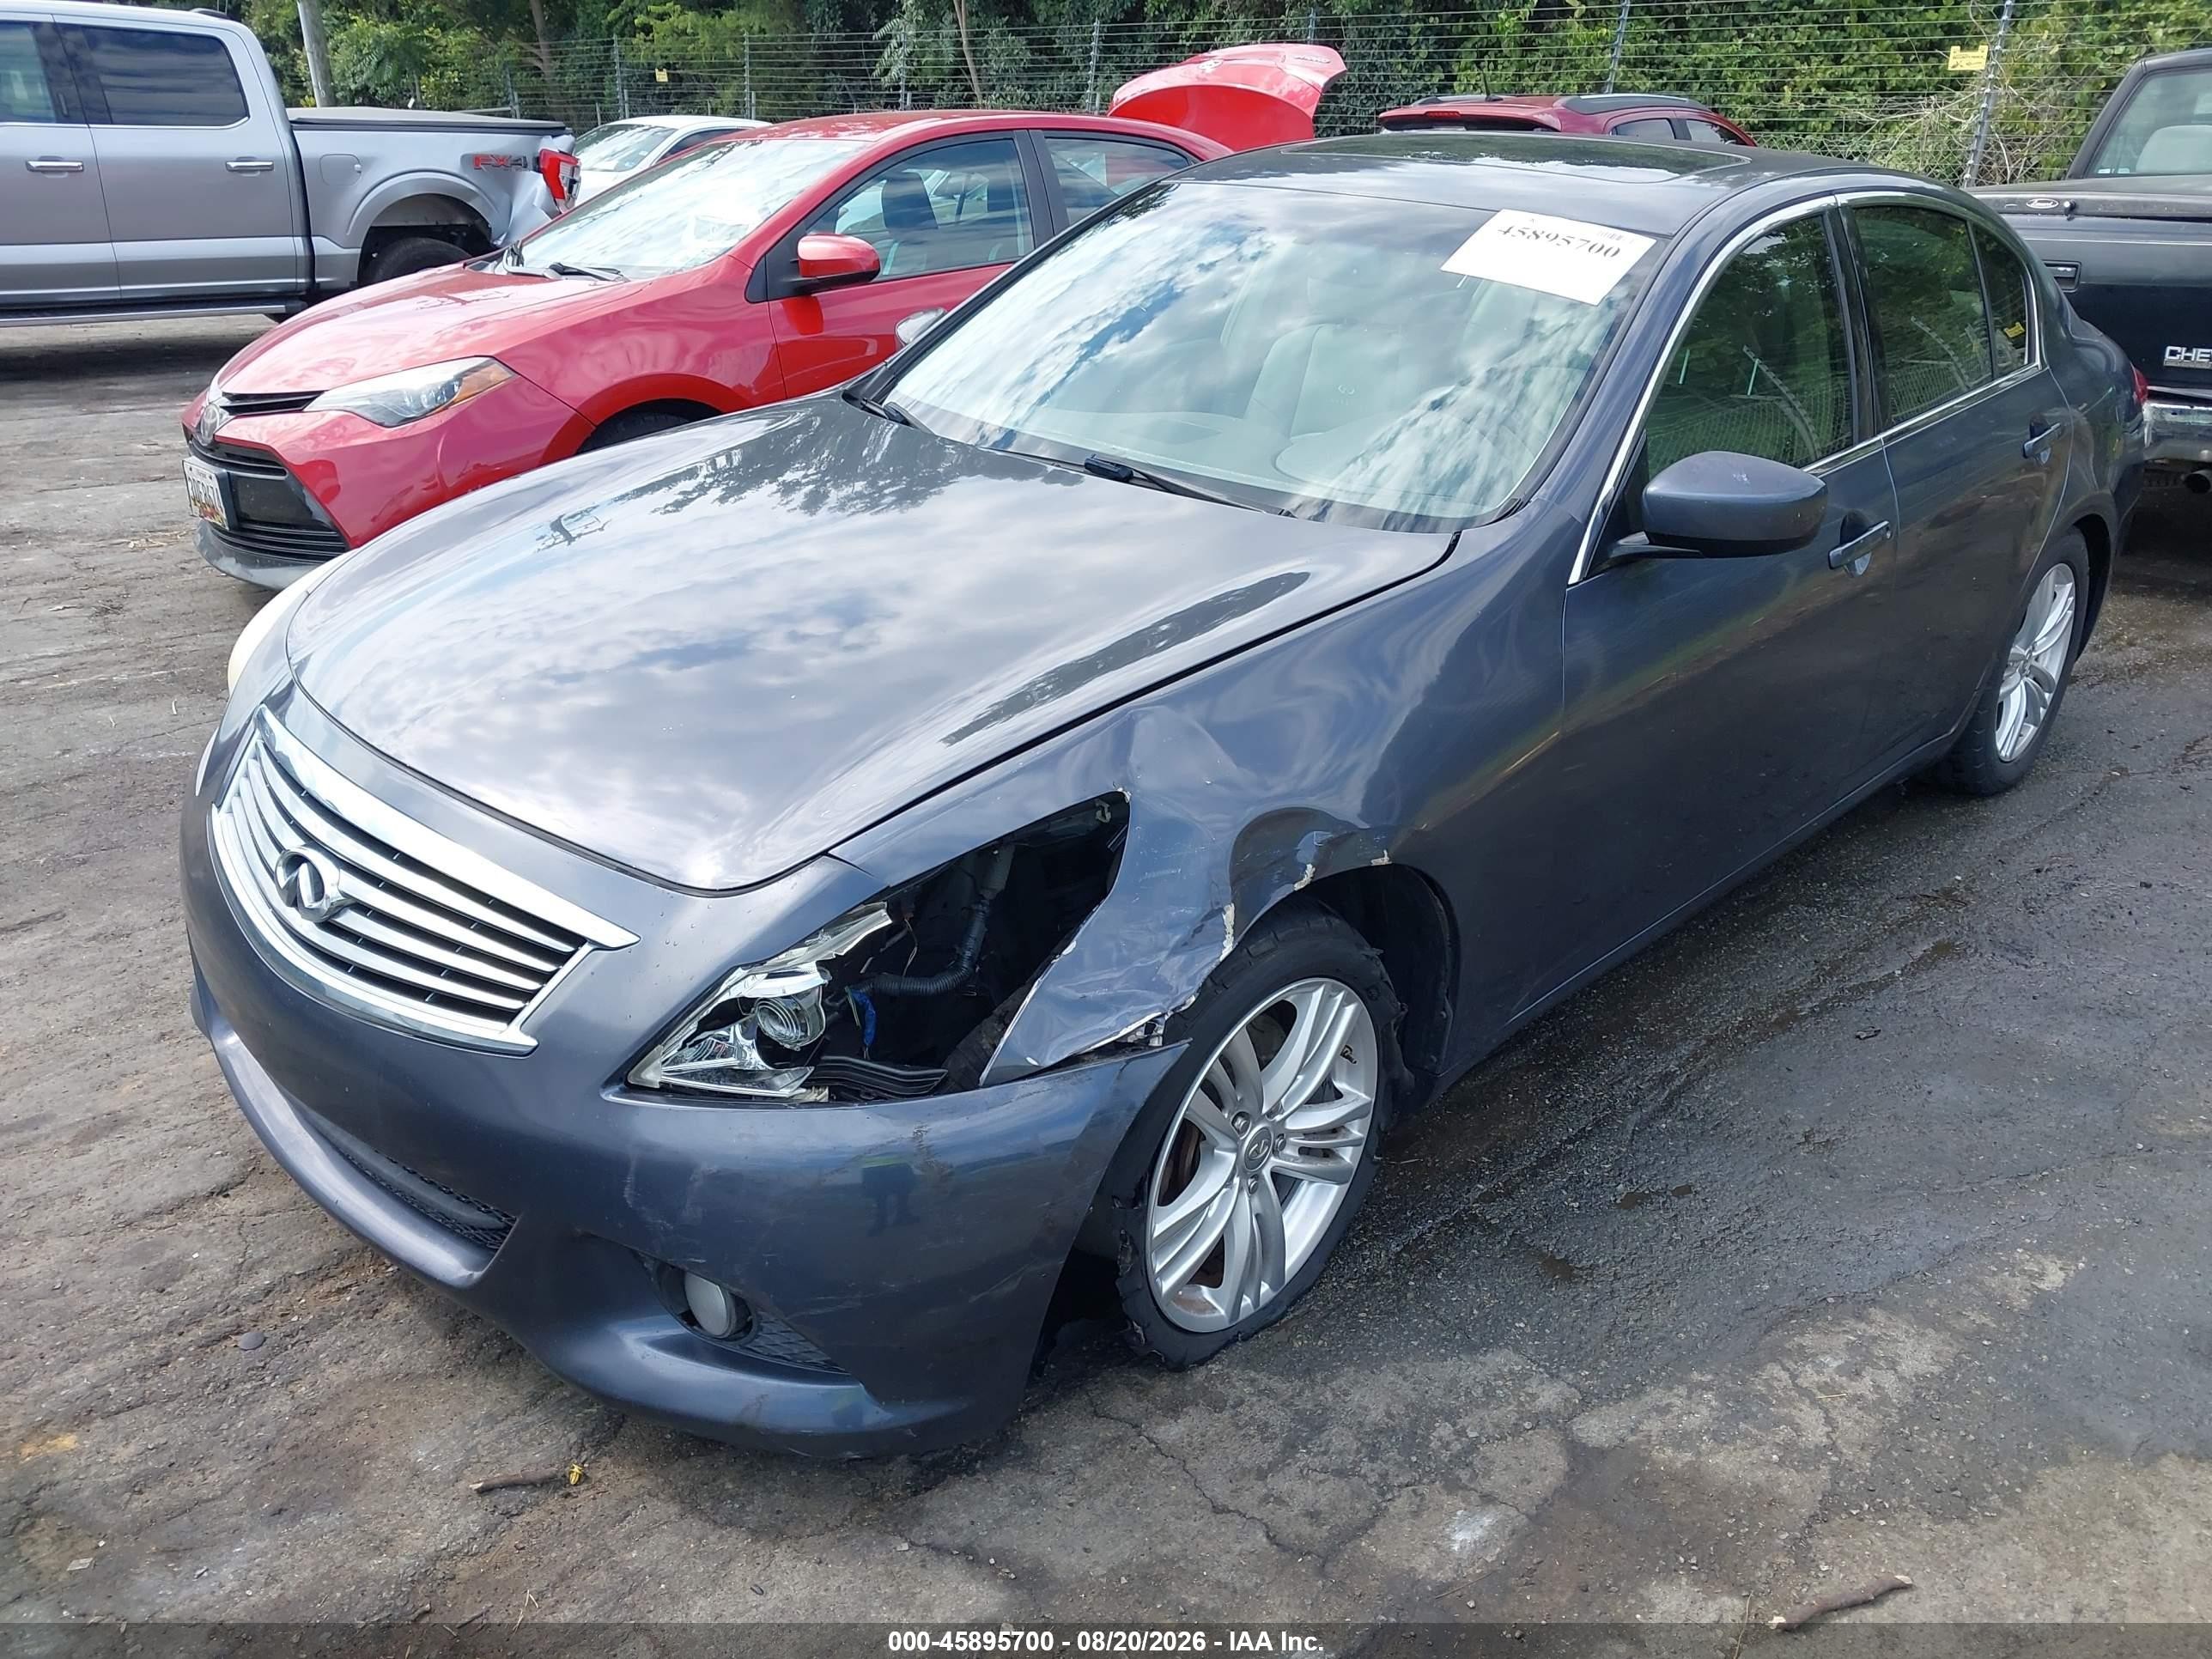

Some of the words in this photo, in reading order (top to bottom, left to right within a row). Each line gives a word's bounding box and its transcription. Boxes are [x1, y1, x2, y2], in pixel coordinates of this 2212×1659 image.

[473, 155, 528, 169] FX4
[1498, 225, 1621, 258] 45895700
[2165, 346, 2212, 362] CHE
